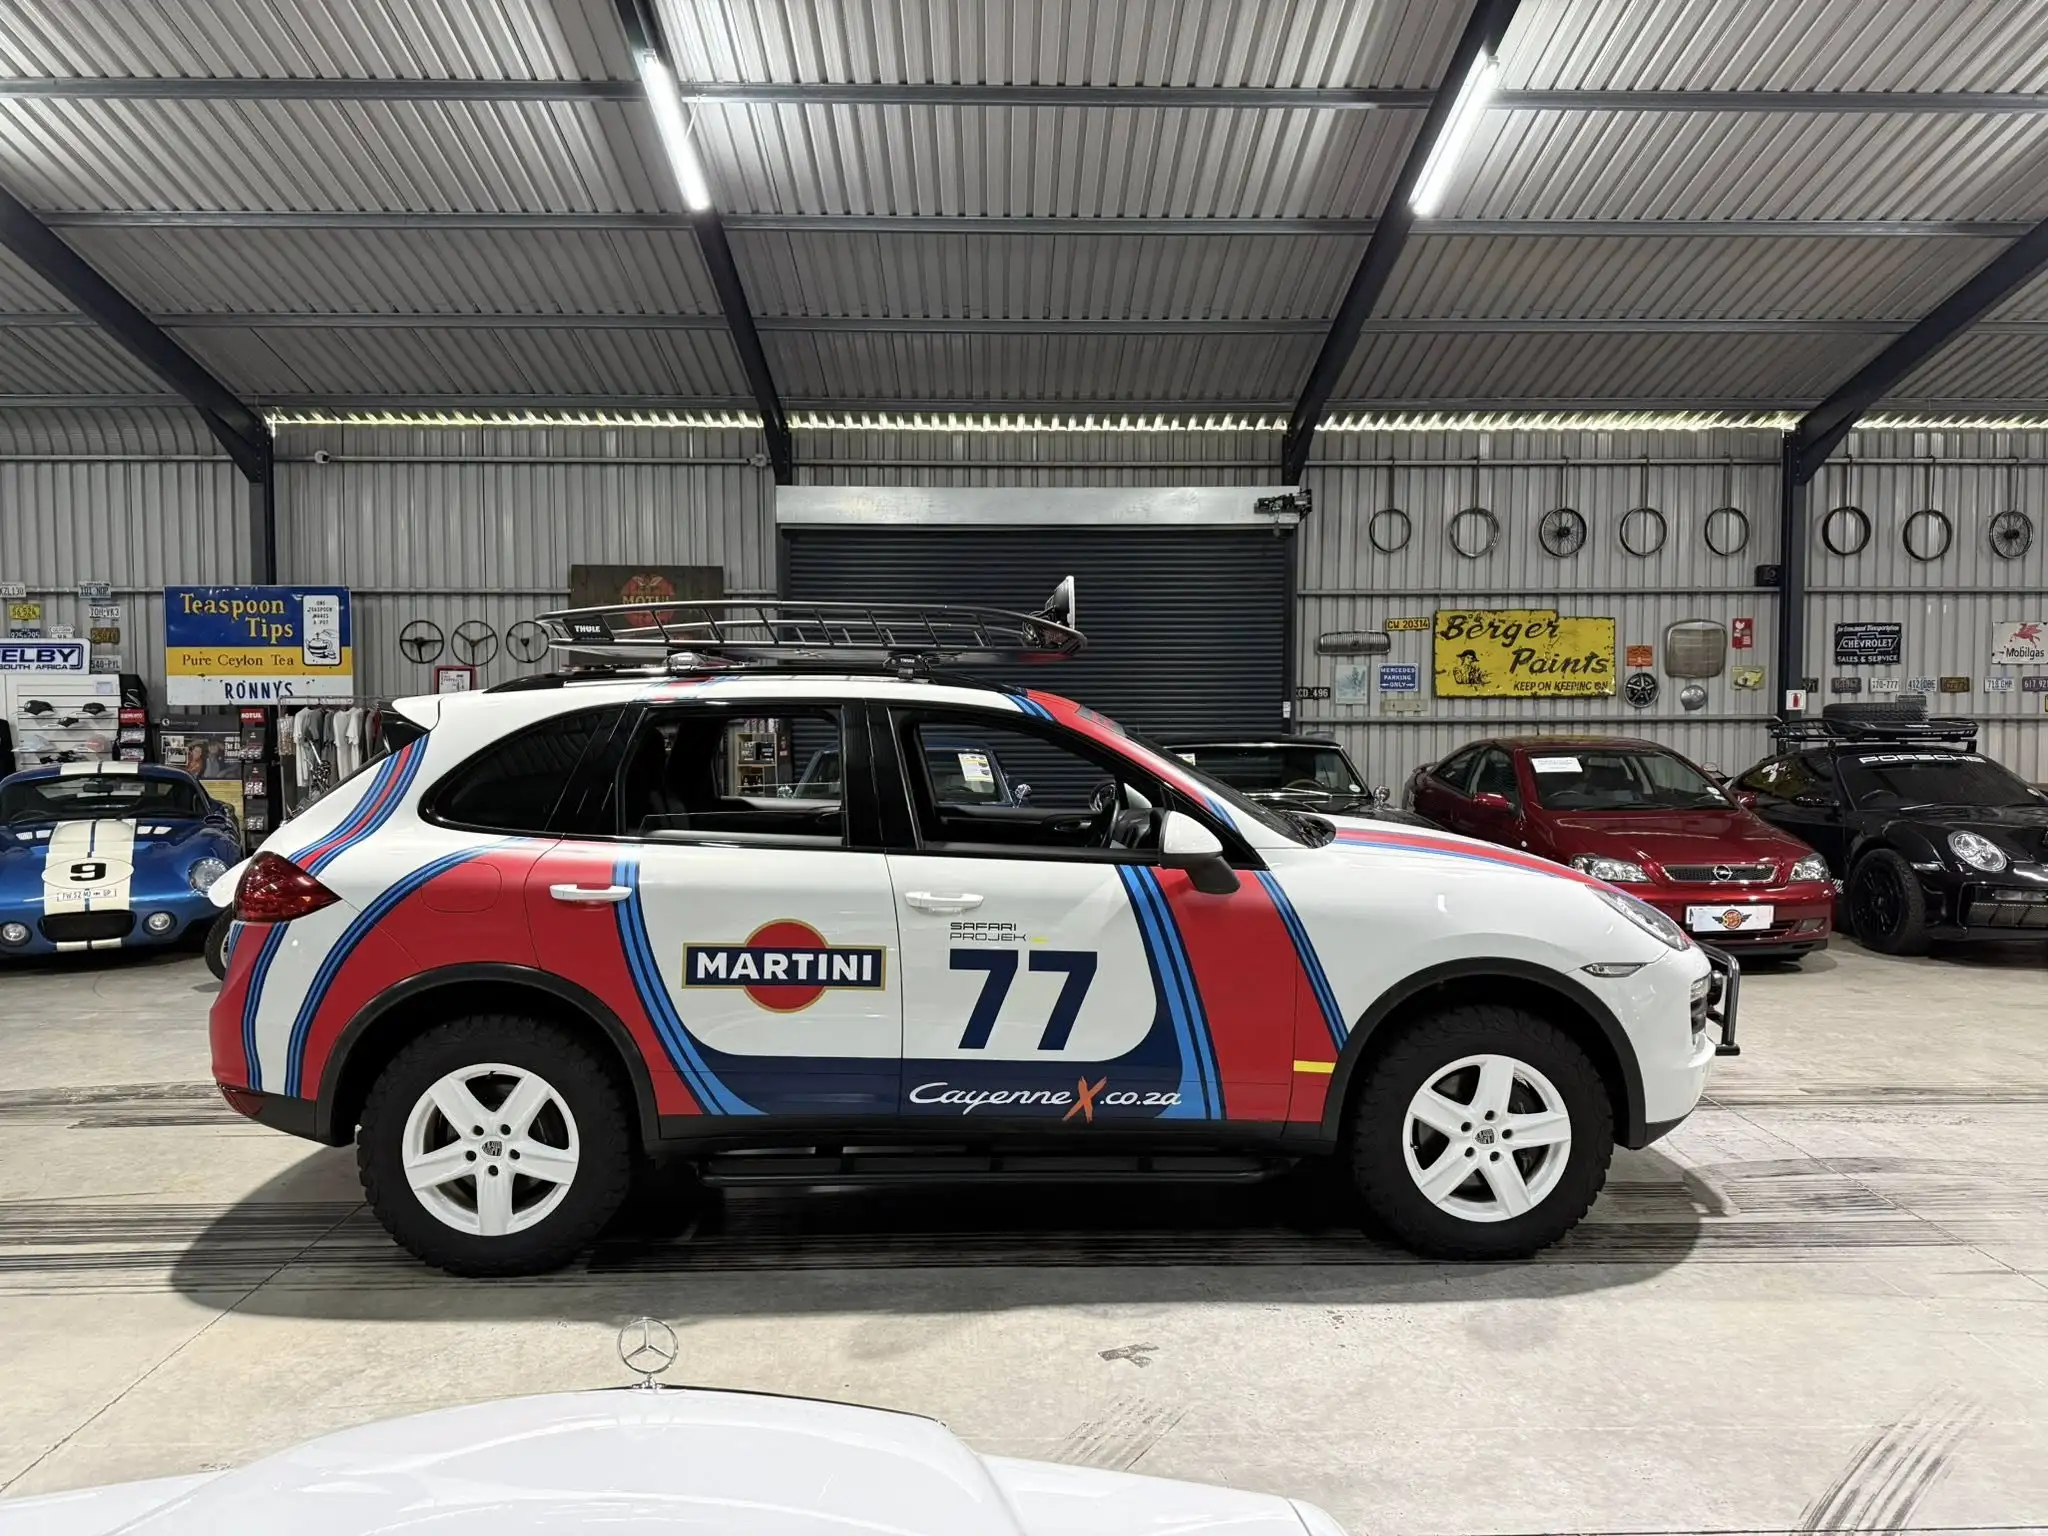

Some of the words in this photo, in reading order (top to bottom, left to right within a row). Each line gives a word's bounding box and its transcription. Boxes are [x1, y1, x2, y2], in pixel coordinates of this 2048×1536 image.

[180, 593, 285, 620] Teaspoon
[574, 625, 600, 633] THULE
[1403, 619, 1429, 629] 20314
[245, 617, 294, 645] Tips
[1440, 614, 1559, 648] Berger
[1842, 638, 1893, 648] CHEVROLET
[1837, 655, 1859, 663] SALES
[2006, 647, 2045, 660] Mobilgas
[182, 654, 212, 666] Pure
[217, 654, 263, 668] Ceylon
[271, 654, 294, 666] Tea
[1509, 647, 1609, 675] Paints
[225, 682, 294, 700] RONNYS
[1514, 681, 1536, 691] KEEP
[1537, 681, 1552, 691] ON
[1554, 680, 1592, 691] KEEPING
[1858, 754, 1987, 764] PORSCHE
[70, 863, 106, 881] 9
[950, 922, 1016, 931] SAFARI
[950, 932, 1027, 941] PROJEK
[696, 951, 873, 982] MARTINI
[950, 949, 1098, 1051] 77
